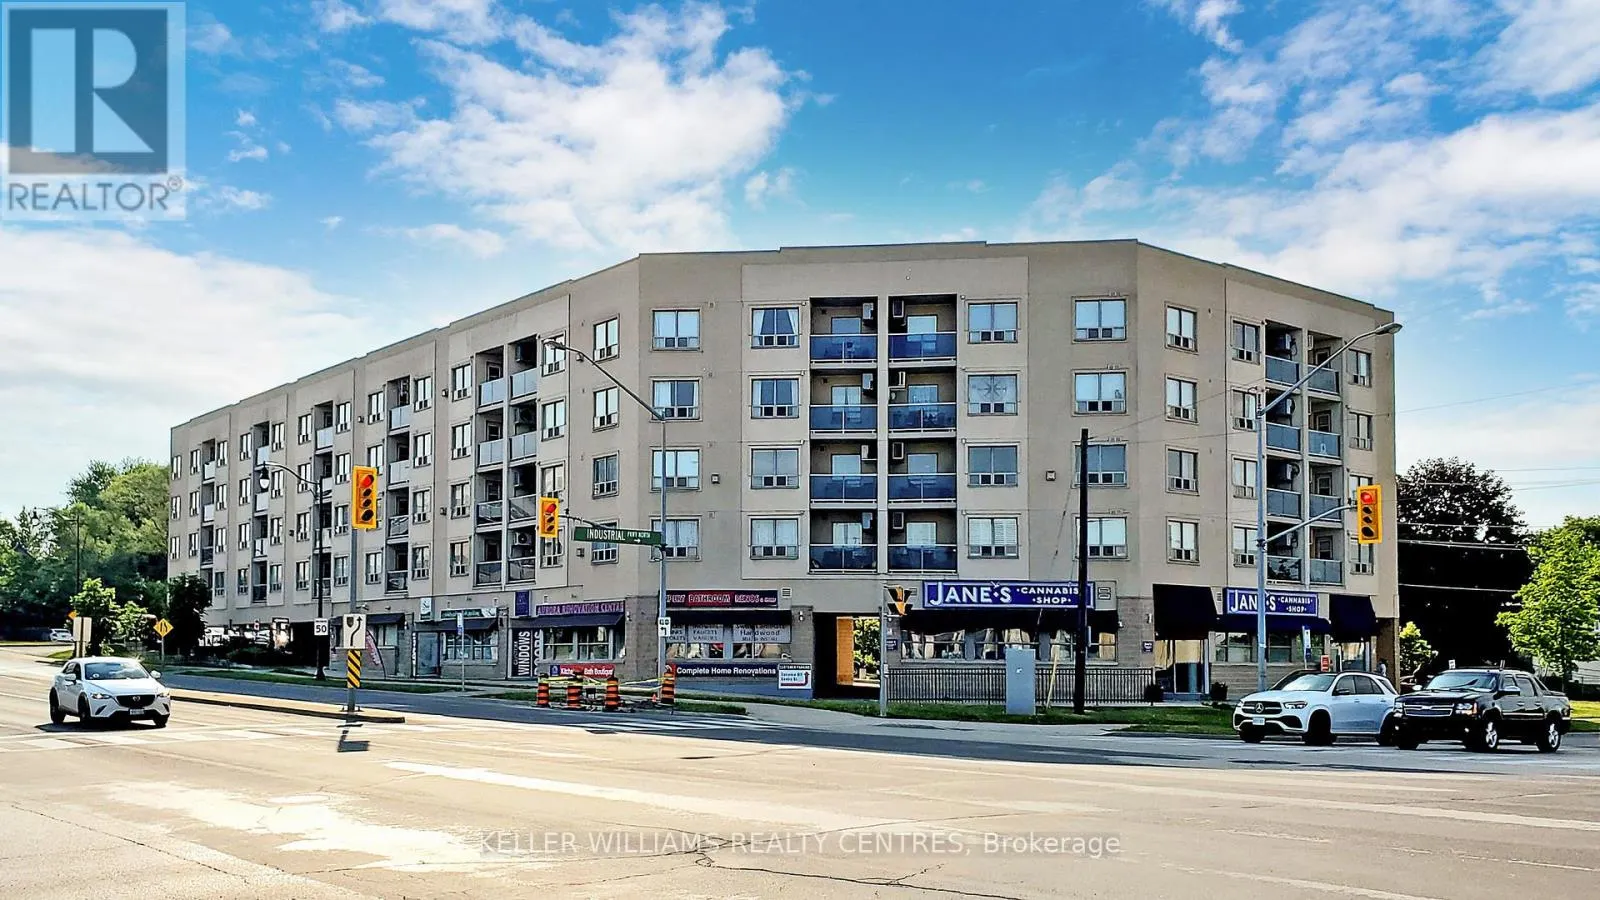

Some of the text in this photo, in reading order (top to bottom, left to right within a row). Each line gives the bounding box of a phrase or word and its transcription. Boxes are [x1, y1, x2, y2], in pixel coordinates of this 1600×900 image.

[587, 529, 625, 541] INDUSTRIAL
[1020, 587, 1079, 595] CANNABIS
[1037, 597, 1067, 605] SHOP
[316, 624, 327, 633] 50
[518, 631, 530, 676] WINDOWS
[676, 667, 710, 676] Complete
[733, 667, 776, 676] Renovations
